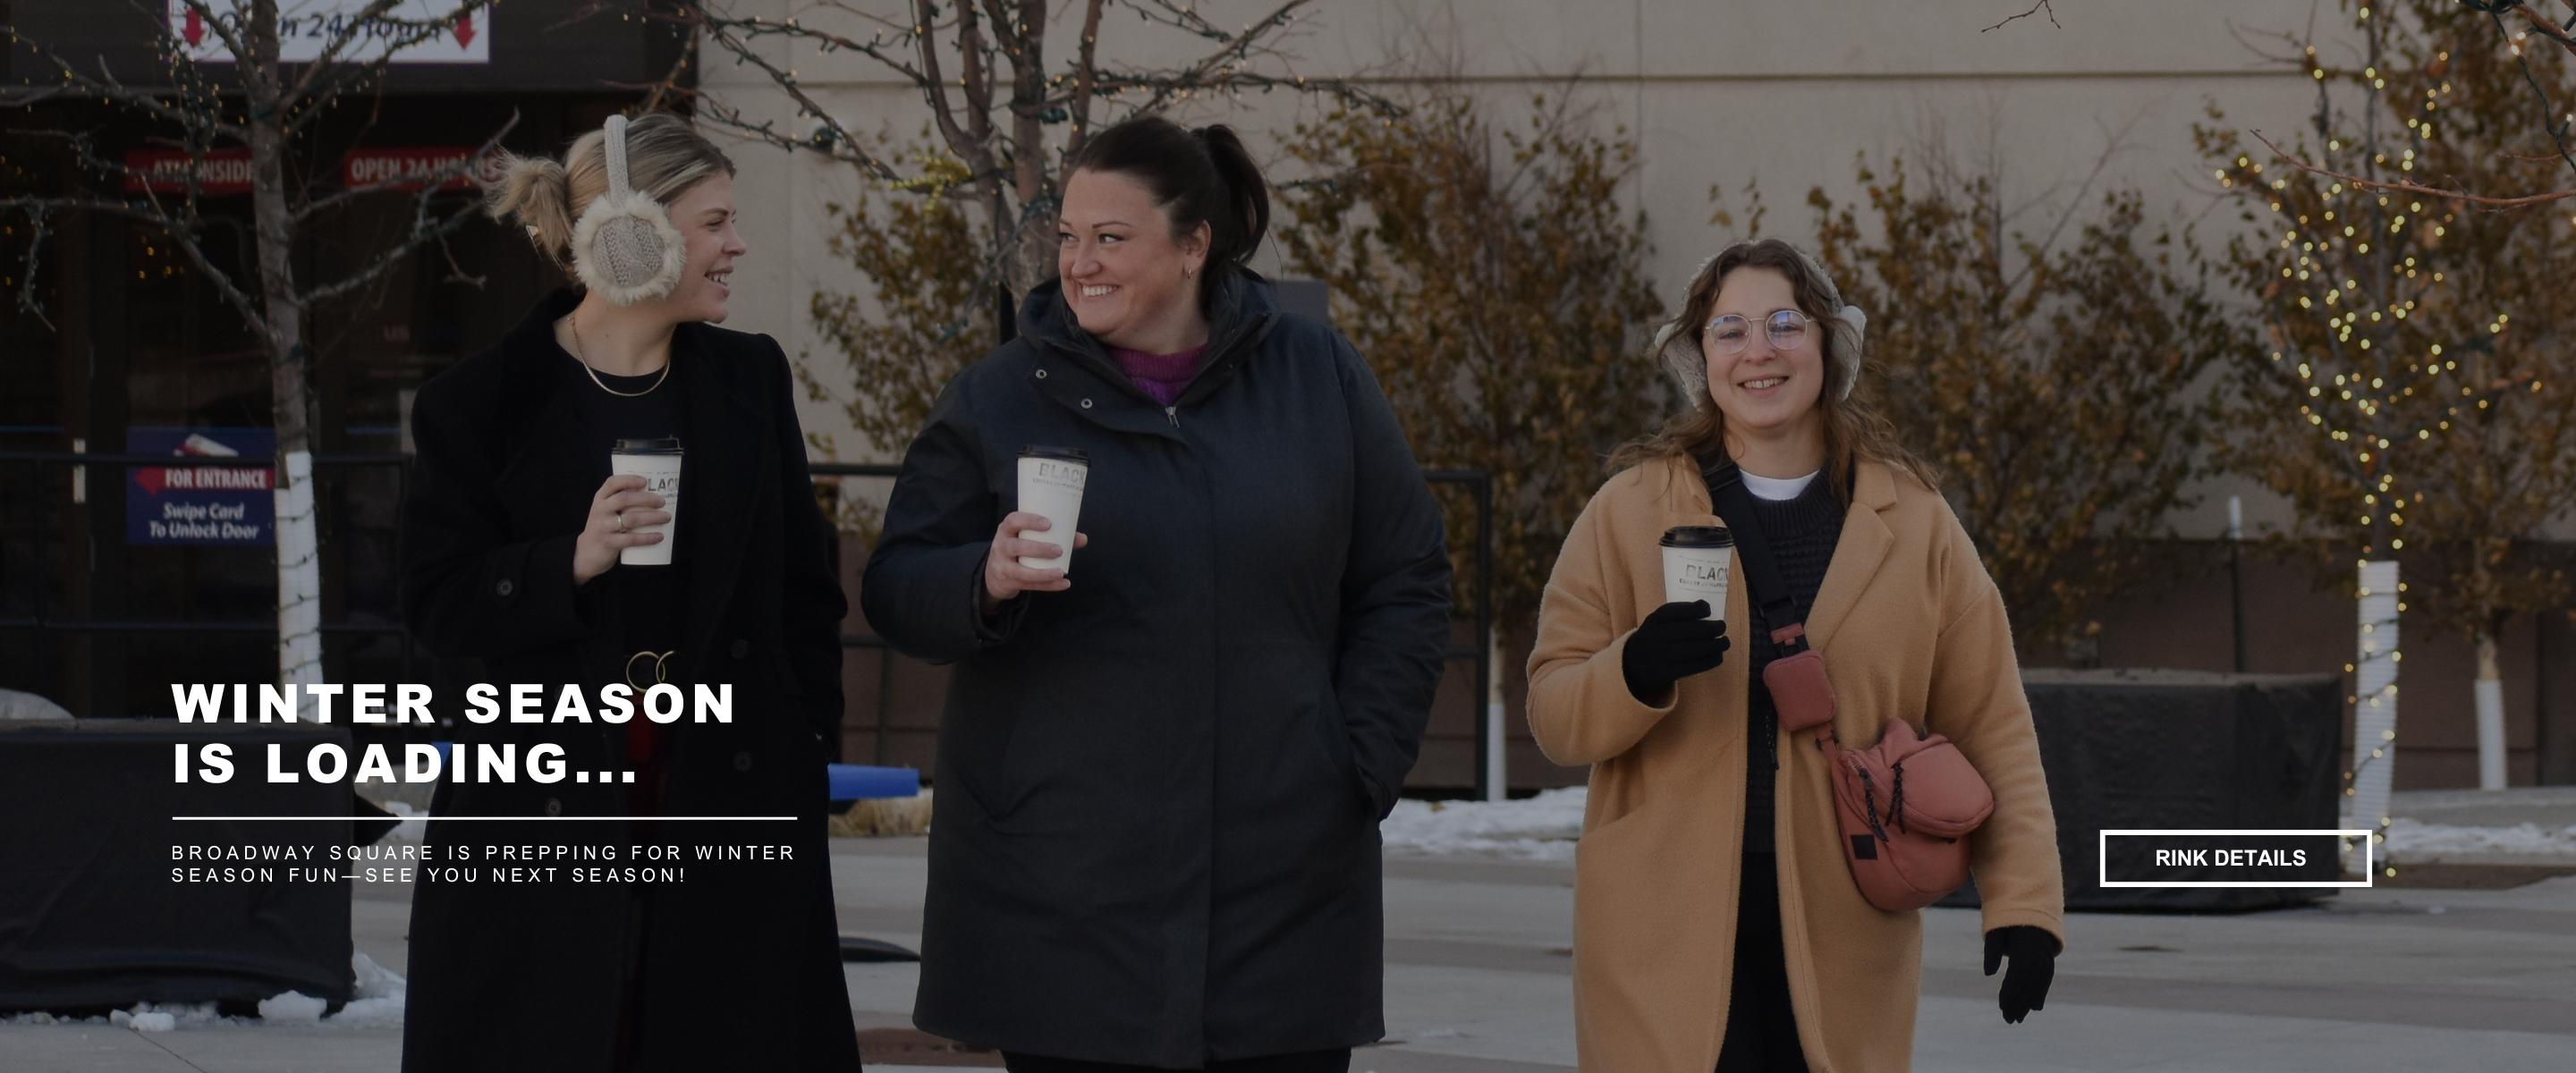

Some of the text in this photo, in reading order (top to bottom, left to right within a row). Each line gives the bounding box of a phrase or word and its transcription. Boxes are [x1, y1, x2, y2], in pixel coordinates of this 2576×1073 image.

[165, 468, 267, 489] FOR ENTRANCE
[163, 502, 245, 520] Swipe Card
[148, 520, 260, 539] To Unlock Door
